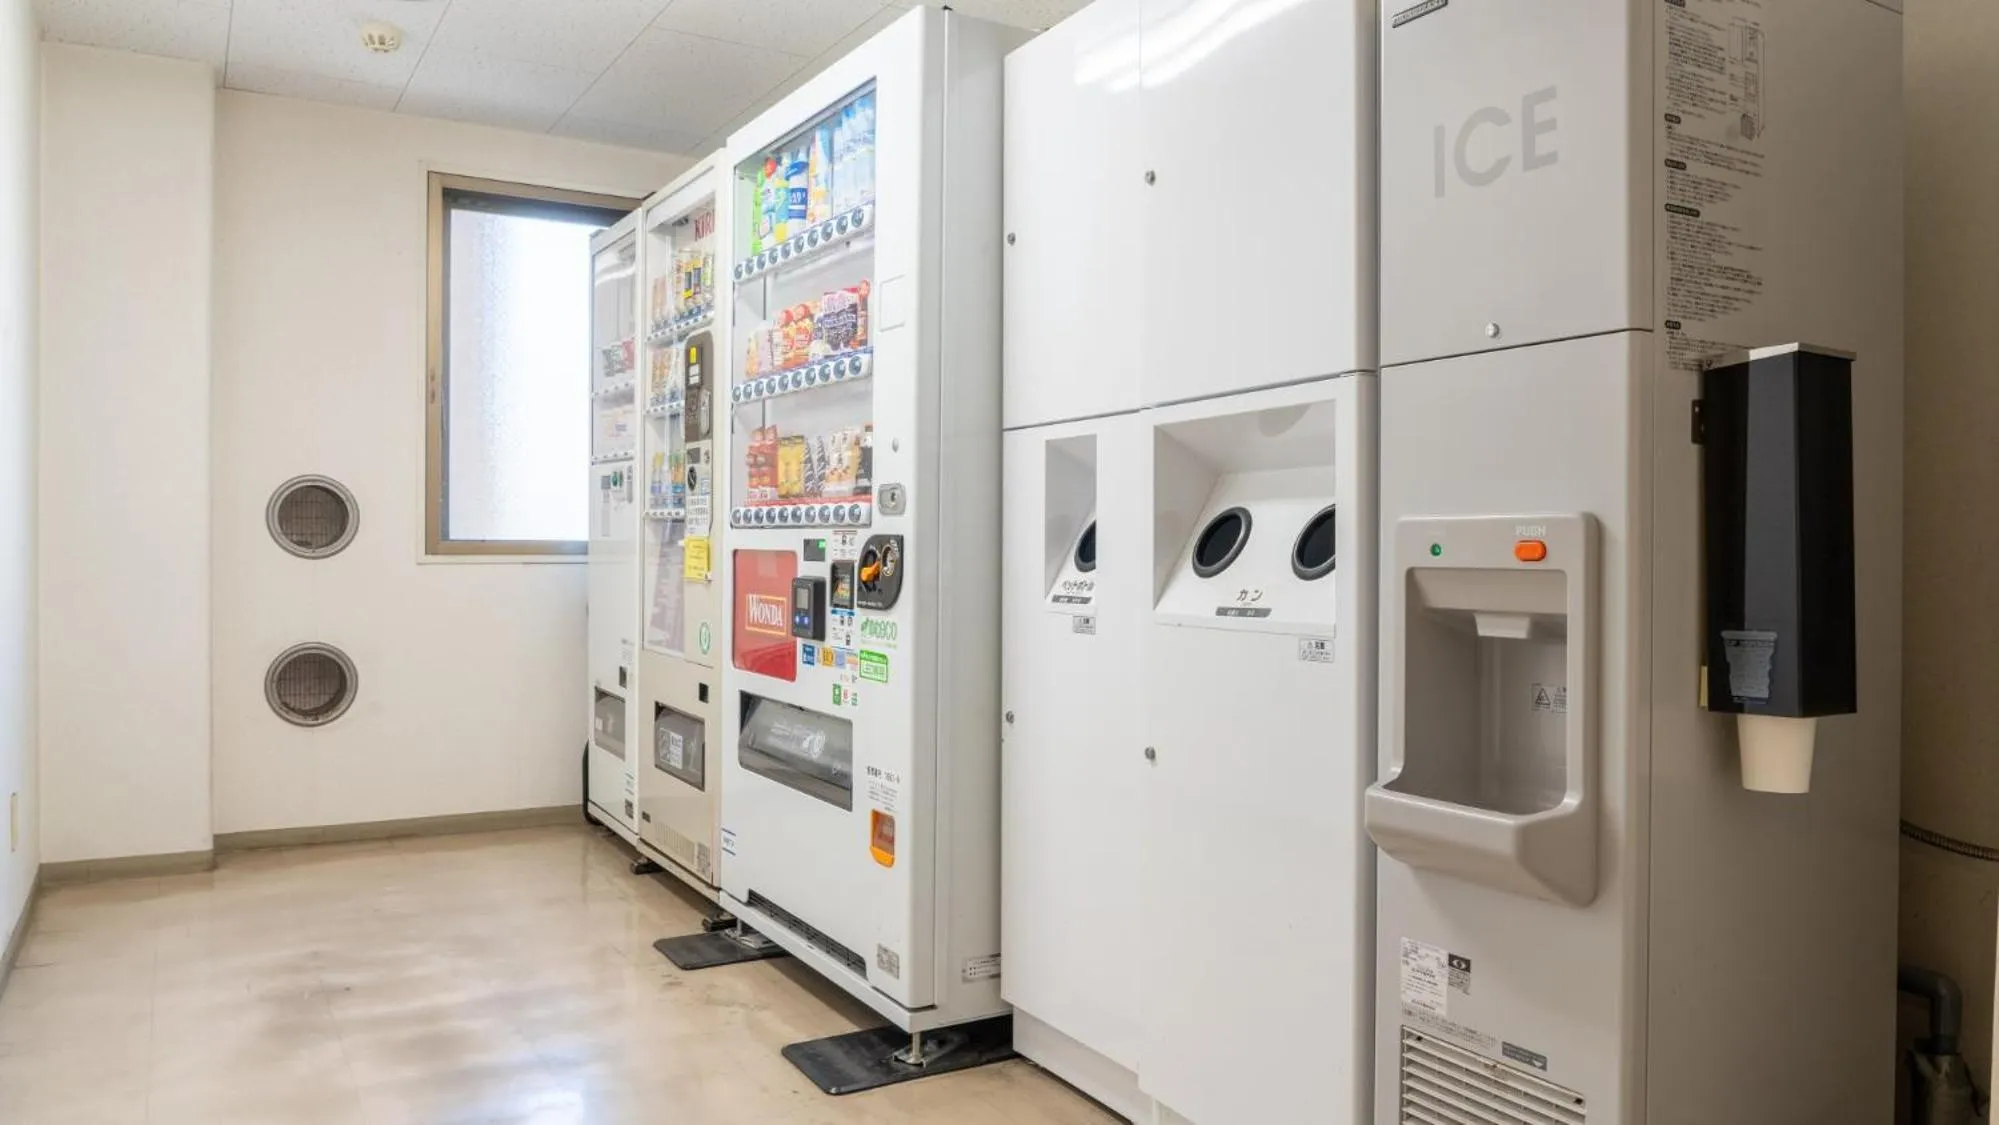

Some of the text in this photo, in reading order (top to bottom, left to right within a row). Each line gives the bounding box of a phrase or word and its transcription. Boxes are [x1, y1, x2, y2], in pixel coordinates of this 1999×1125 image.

[1434, 84, 1558, 198] ICE
[1515, 525, 1546, 537] PUSH
[1236, 588, 1263, 602] カン
[749, 594, 783, 627] WONDA
